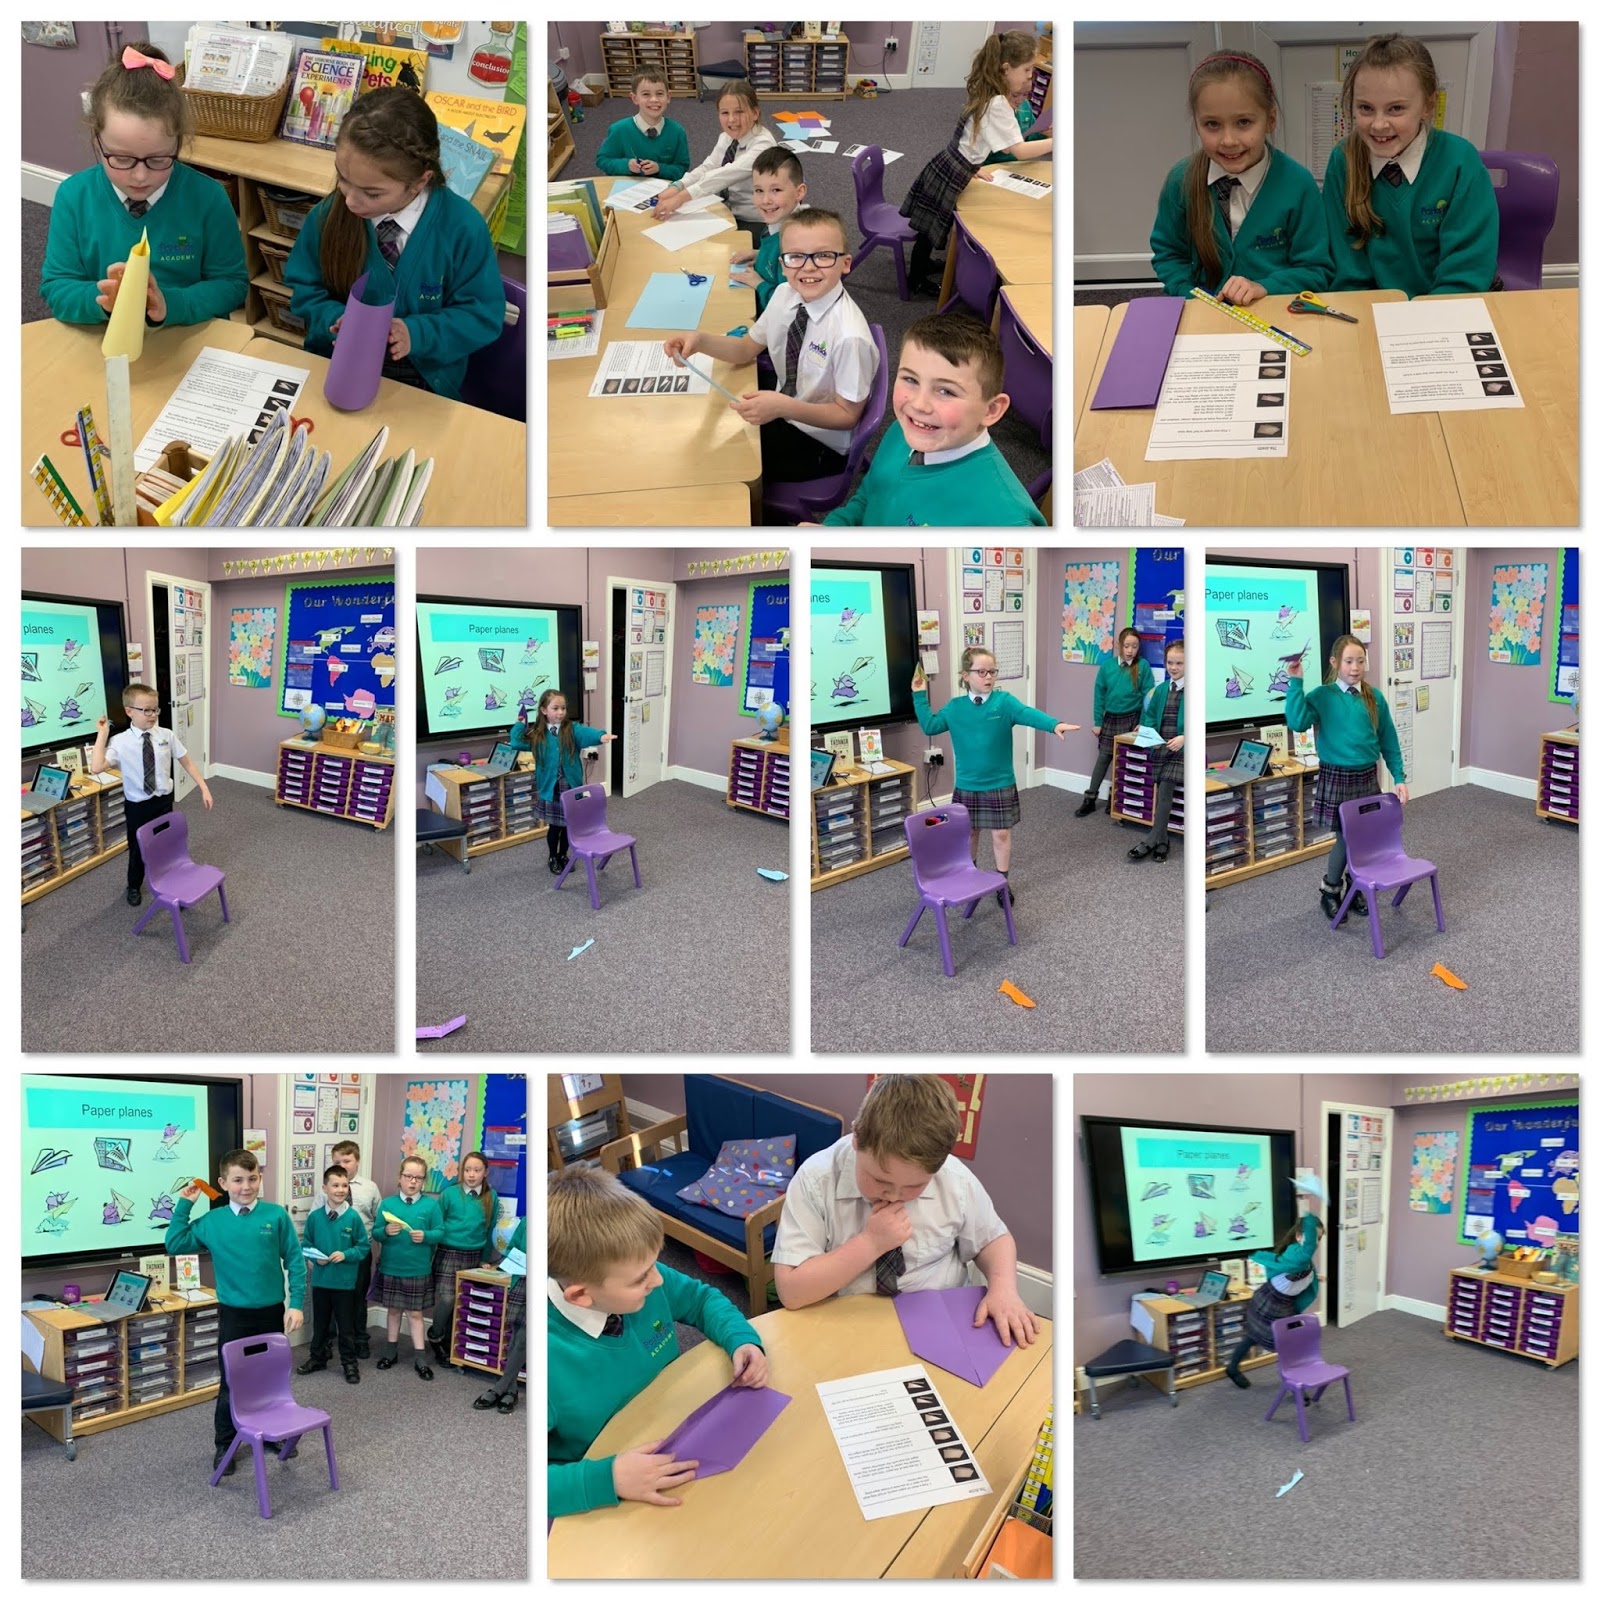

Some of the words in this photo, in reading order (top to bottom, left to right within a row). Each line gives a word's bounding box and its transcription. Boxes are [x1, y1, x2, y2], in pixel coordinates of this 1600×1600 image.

[302, 60, 354, 78] SCIENCE
[301, 72, 352, 86] EXPERIMENTS
[434, 95, 466, 108] OSCAR
[466, 102, 480, 111] and
[482, 104, 495, 112] the
[496, 106, 518, 116] BIRD
[464, 142, 488, 161] SNAIL
[1152, 548, 1180, 561] Our
[766, 595, 788, 605] Our
[1205, 588, 1234, 602] Paper
[1238, 590, 1268, 602] planes
[304, 597, 326, 608] Our
[24, 624, 54, 635] planes
[468, 624, 492, 634] Paper
[494, 626, 519, 634] planes
[82, 1104, 116, 1118] Paper
[118, 1106, 153, 1119] planes
[651, 1330, 674, 1358] ACADEMY
